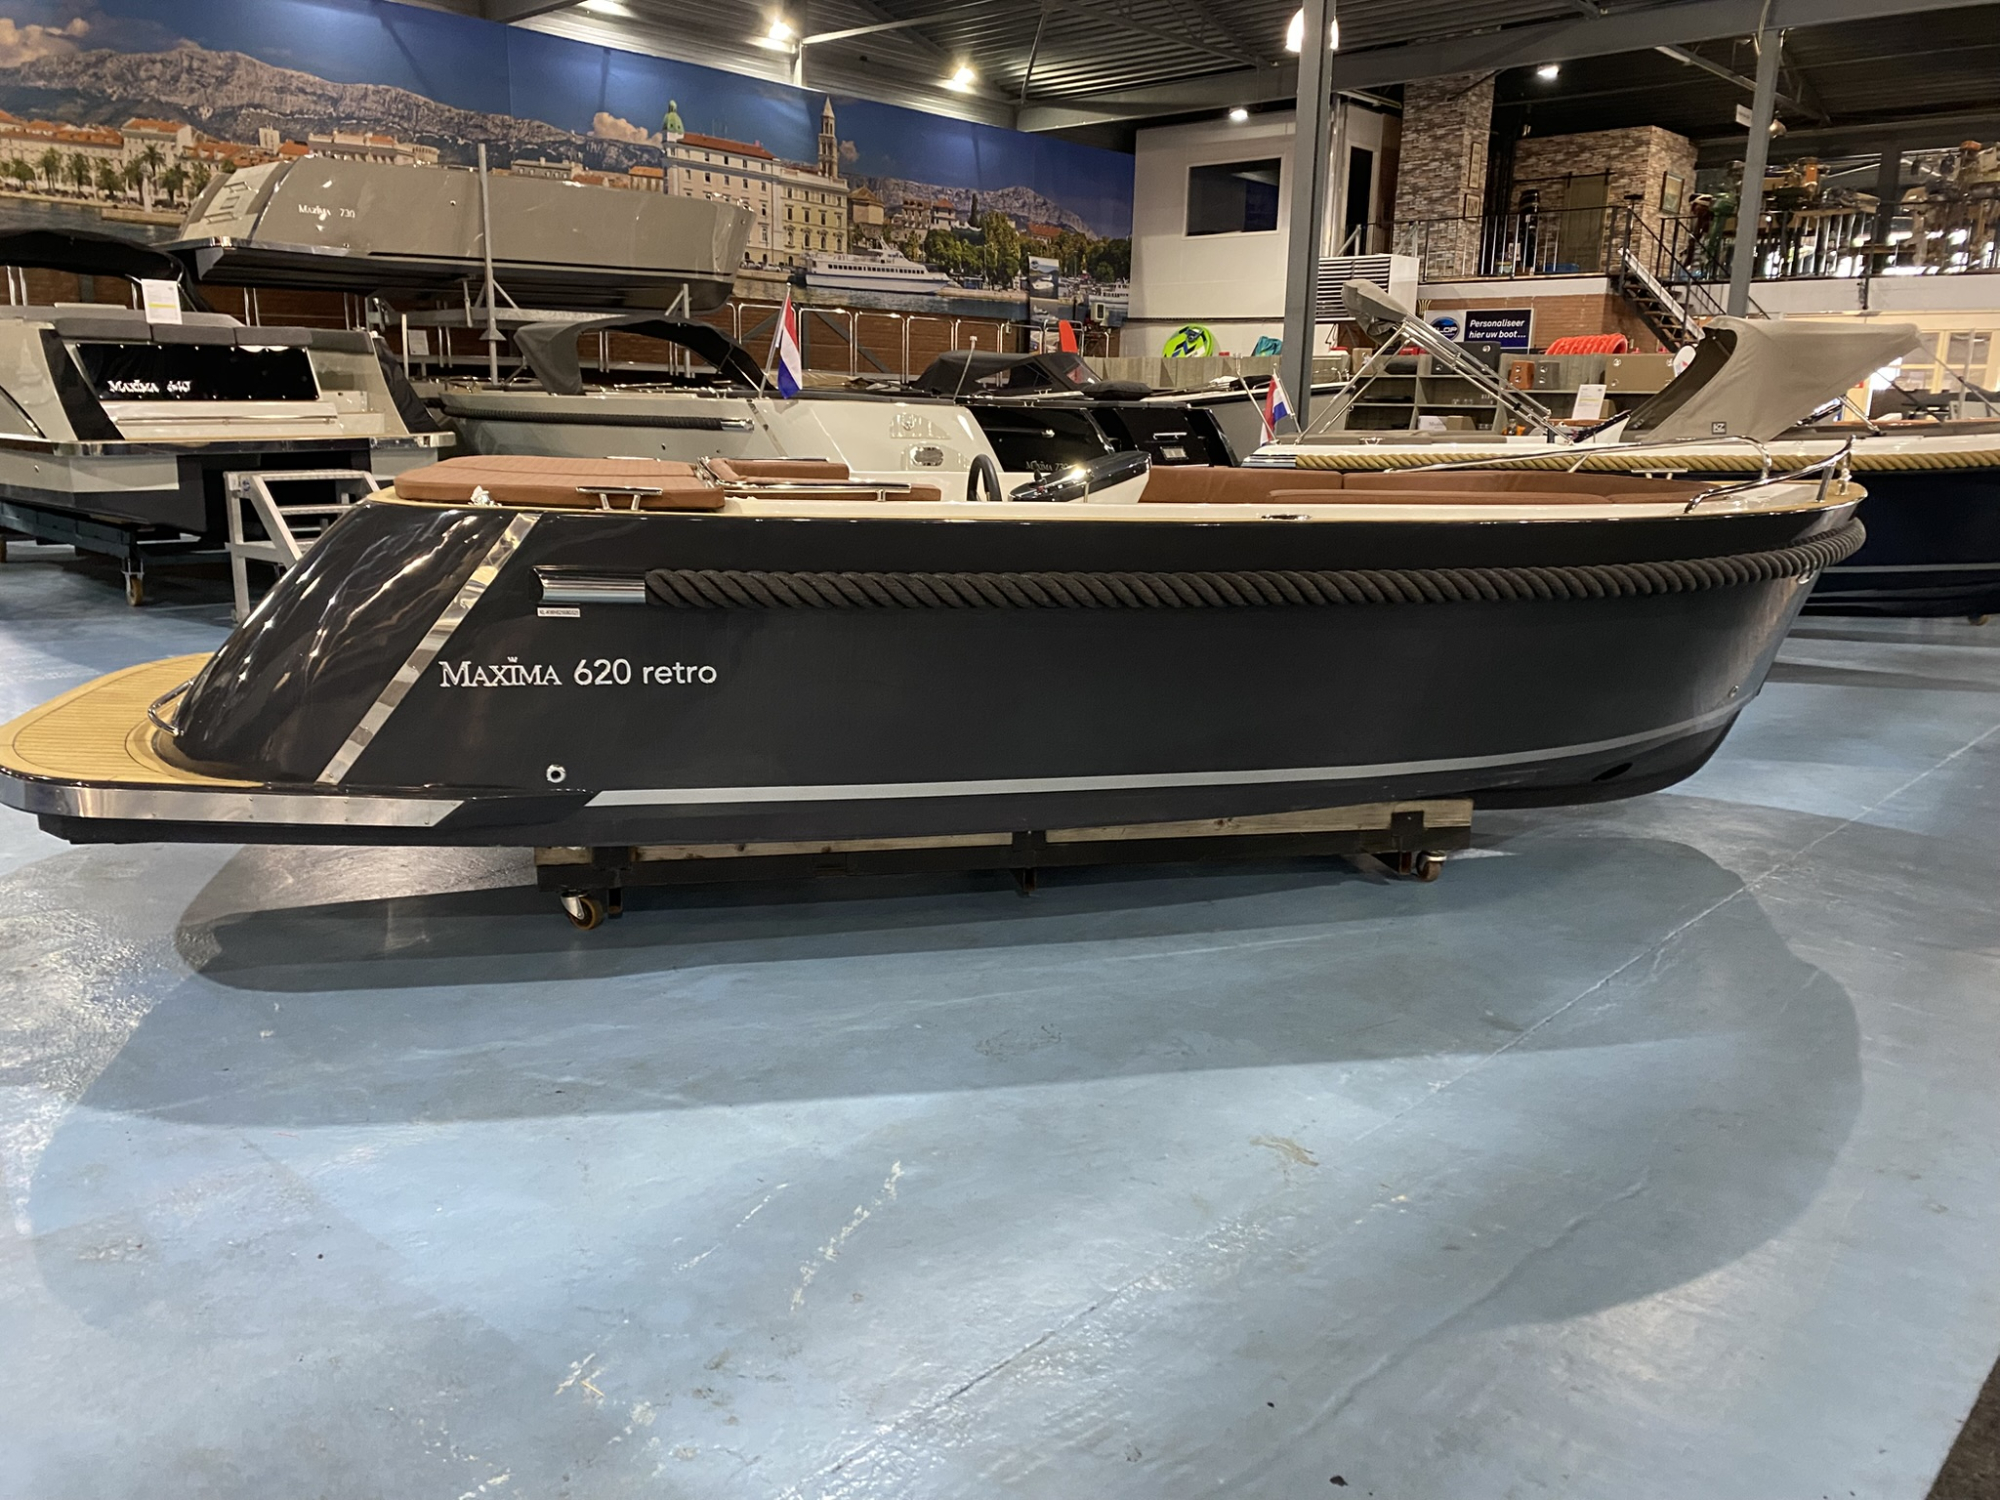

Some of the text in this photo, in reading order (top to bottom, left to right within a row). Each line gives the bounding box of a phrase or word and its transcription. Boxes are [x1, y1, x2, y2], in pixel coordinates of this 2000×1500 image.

[1469, 319, 1525, 328] Personaliseer
[1468, 331, 1484, 339] hier
[573, 659, 632, 686] 620
[642, 662, 717, 684] retro
